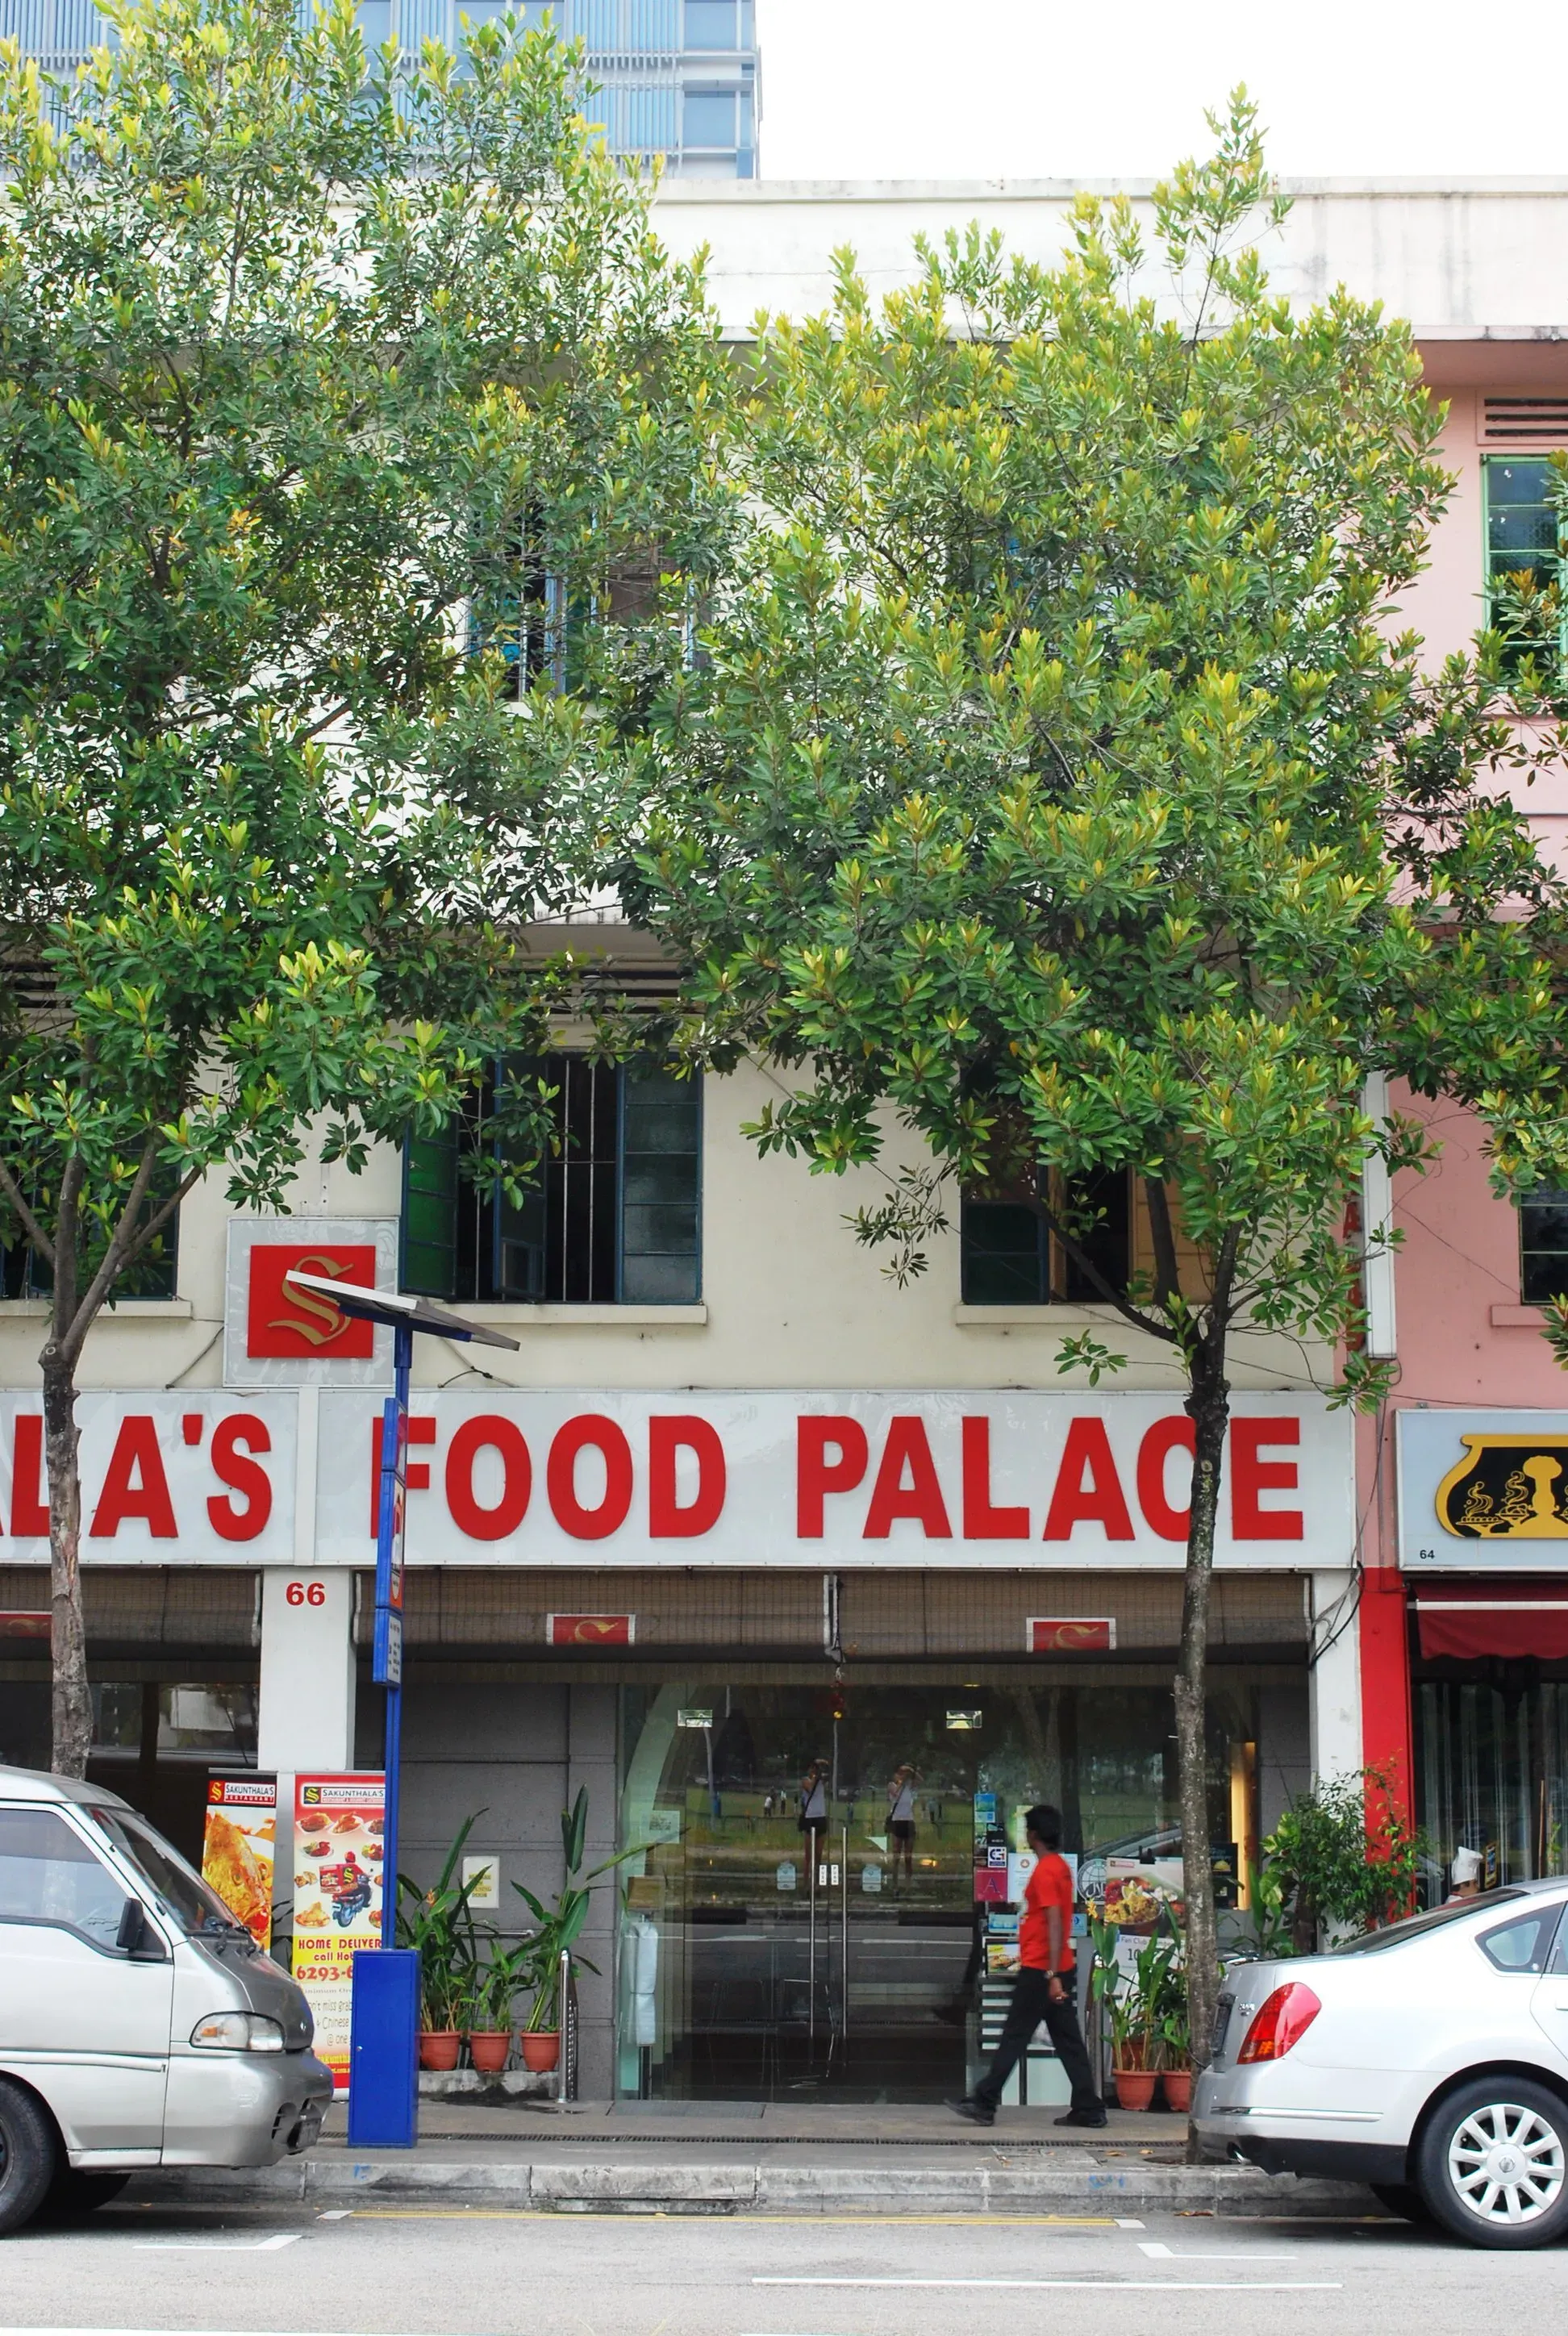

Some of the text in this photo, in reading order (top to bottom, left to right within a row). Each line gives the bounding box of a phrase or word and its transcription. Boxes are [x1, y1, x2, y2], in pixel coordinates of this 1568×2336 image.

[0, 1413, 1304, 1542] LA'S FOOD PALACE
[1420, 1549, 1435, 1559] 64
[286, 1582, 325, 1606] 66
[225, 1784, 274, 1796] SAKUNTHALA'S
[323, 1789, 384, 1797] SAKUNTHALA'S
[298, 1938, 382, 1949] HOME DELIVER
[314, 1952, 353, 1961] call Hot
[297, 1965, 353, 1981] 6293-6
[323, 2017, 349, 2029] Chinese
